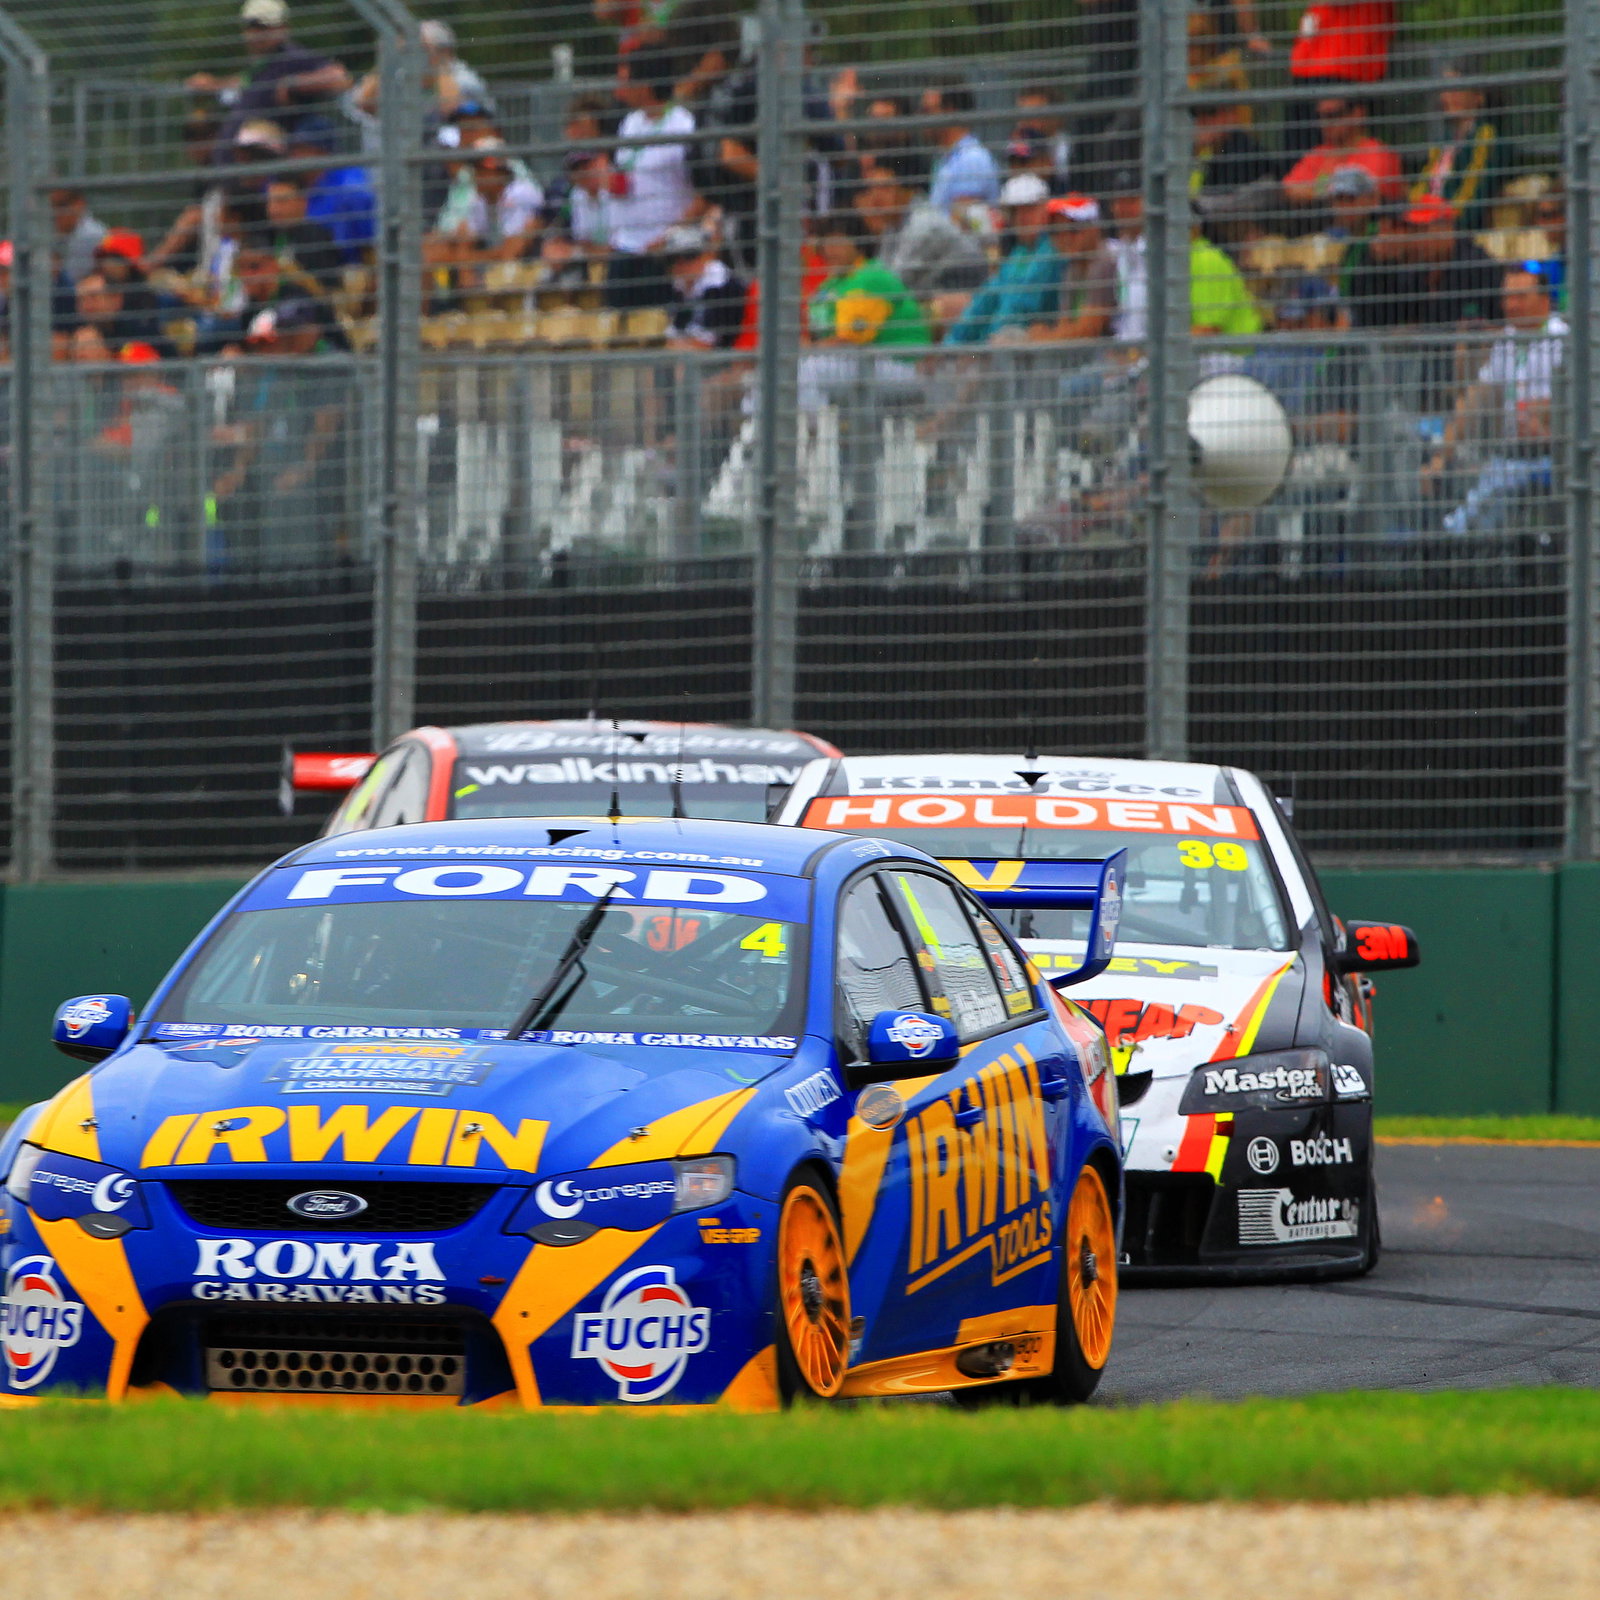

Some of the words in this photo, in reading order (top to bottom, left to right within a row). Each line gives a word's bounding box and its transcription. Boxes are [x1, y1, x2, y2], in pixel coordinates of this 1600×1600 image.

[859, 776, 1202, 797] KingGee
[825, 798, 1237, 834] HOLDEN
[335, 845, 763, 868] www.irwinracing.com.au
[1176, 839, 1249, 872] 39
[287, 865, 768, 904] FORD
[739, 922, 787, 958] 4
[1355, 926, 1409, 961] 3M
[221, 1024, 304, 1038] ROMA
[549, 1031, 637, 1045] ROMA
[288, 1069, 477, 1083] TRADESMAN
[290, 1058, 478, 1073] ULTIMATE
[1204, 1065, 1317, 1095] Master
[302, 1081, 433, 1092] CHALLENGE
[140, 1105, 550, 1173] IRWIN
[1290, 1137, 1354, 1166] BOSCH
[906, 1042, 1050, 1274] IRWIN
[30, 1170, 98, 1194] coregas
[583, 1180, 677, 1203] coregas
[303, 1194, 350, 1212] Ford
[999, 1201, 1052, 1272] TOOLS
[193, 1238, 447, 1281] ROMA
[579, 1313, 705, 1352] FUCHS
